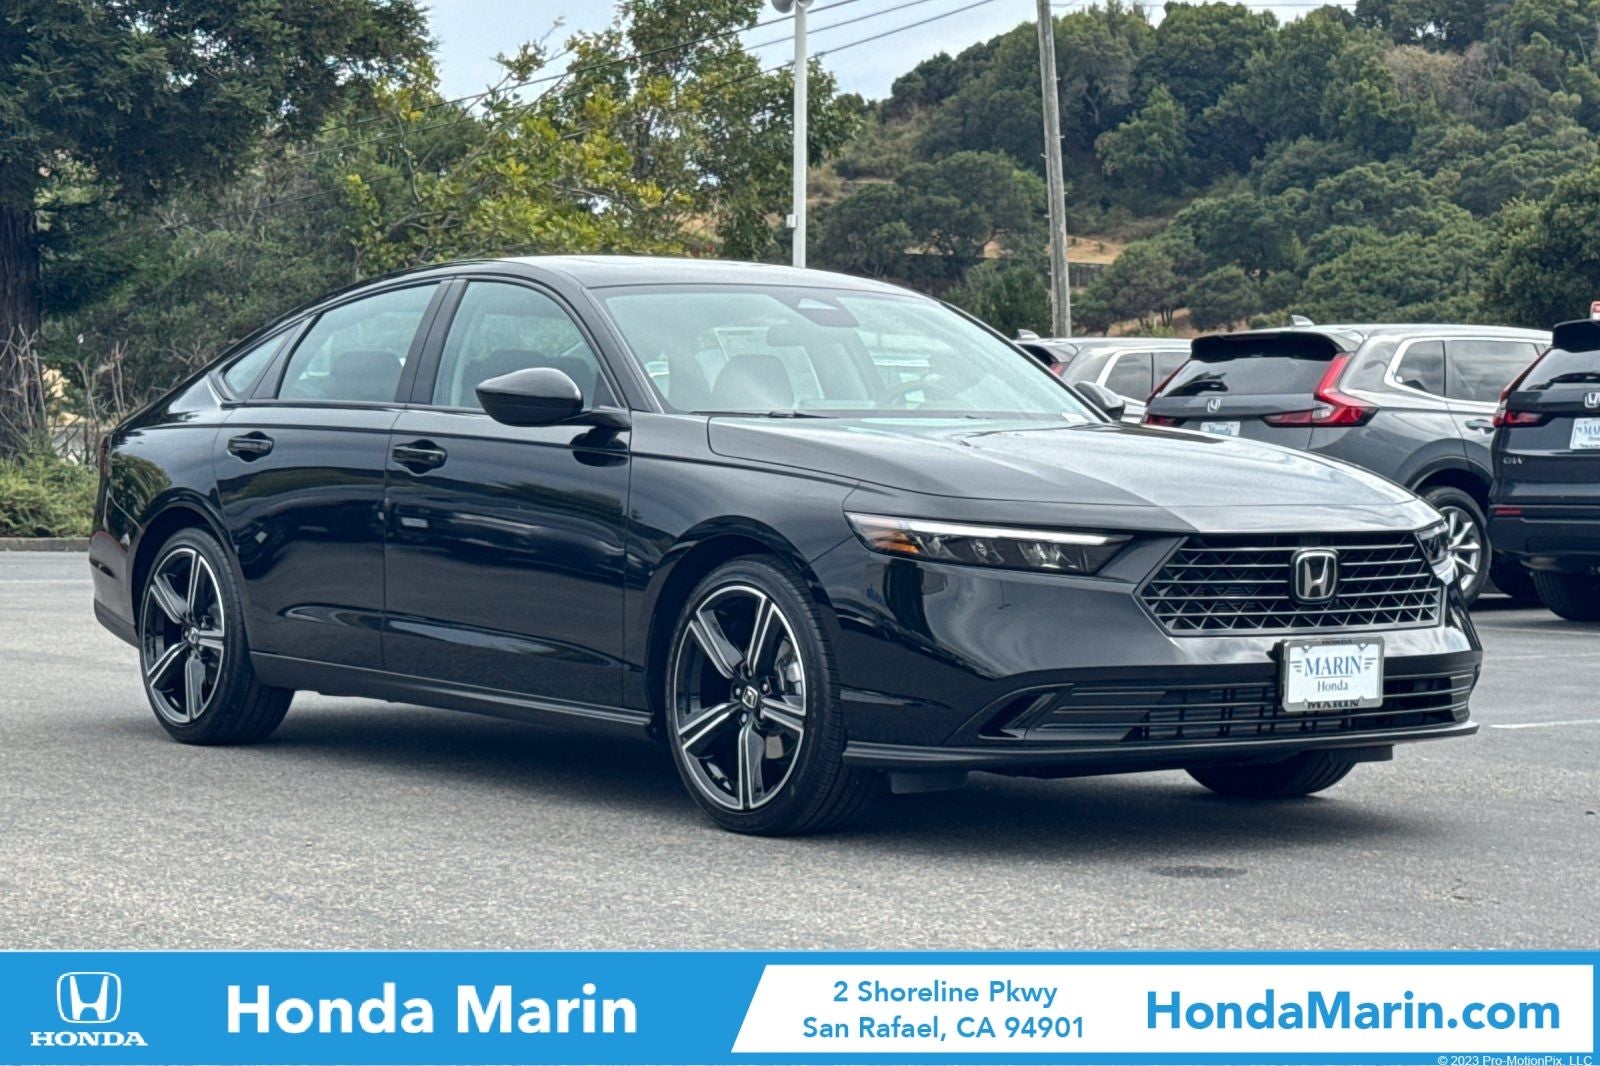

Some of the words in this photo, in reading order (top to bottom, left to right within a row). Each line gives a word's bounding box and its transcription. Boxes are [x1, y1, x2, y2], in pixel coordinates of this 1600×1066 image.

[1305, 655, 1363, 677] MARIN
[1317, 679, 1349, 692] Honda
[1307, 699, 1360, 709] MARIN
